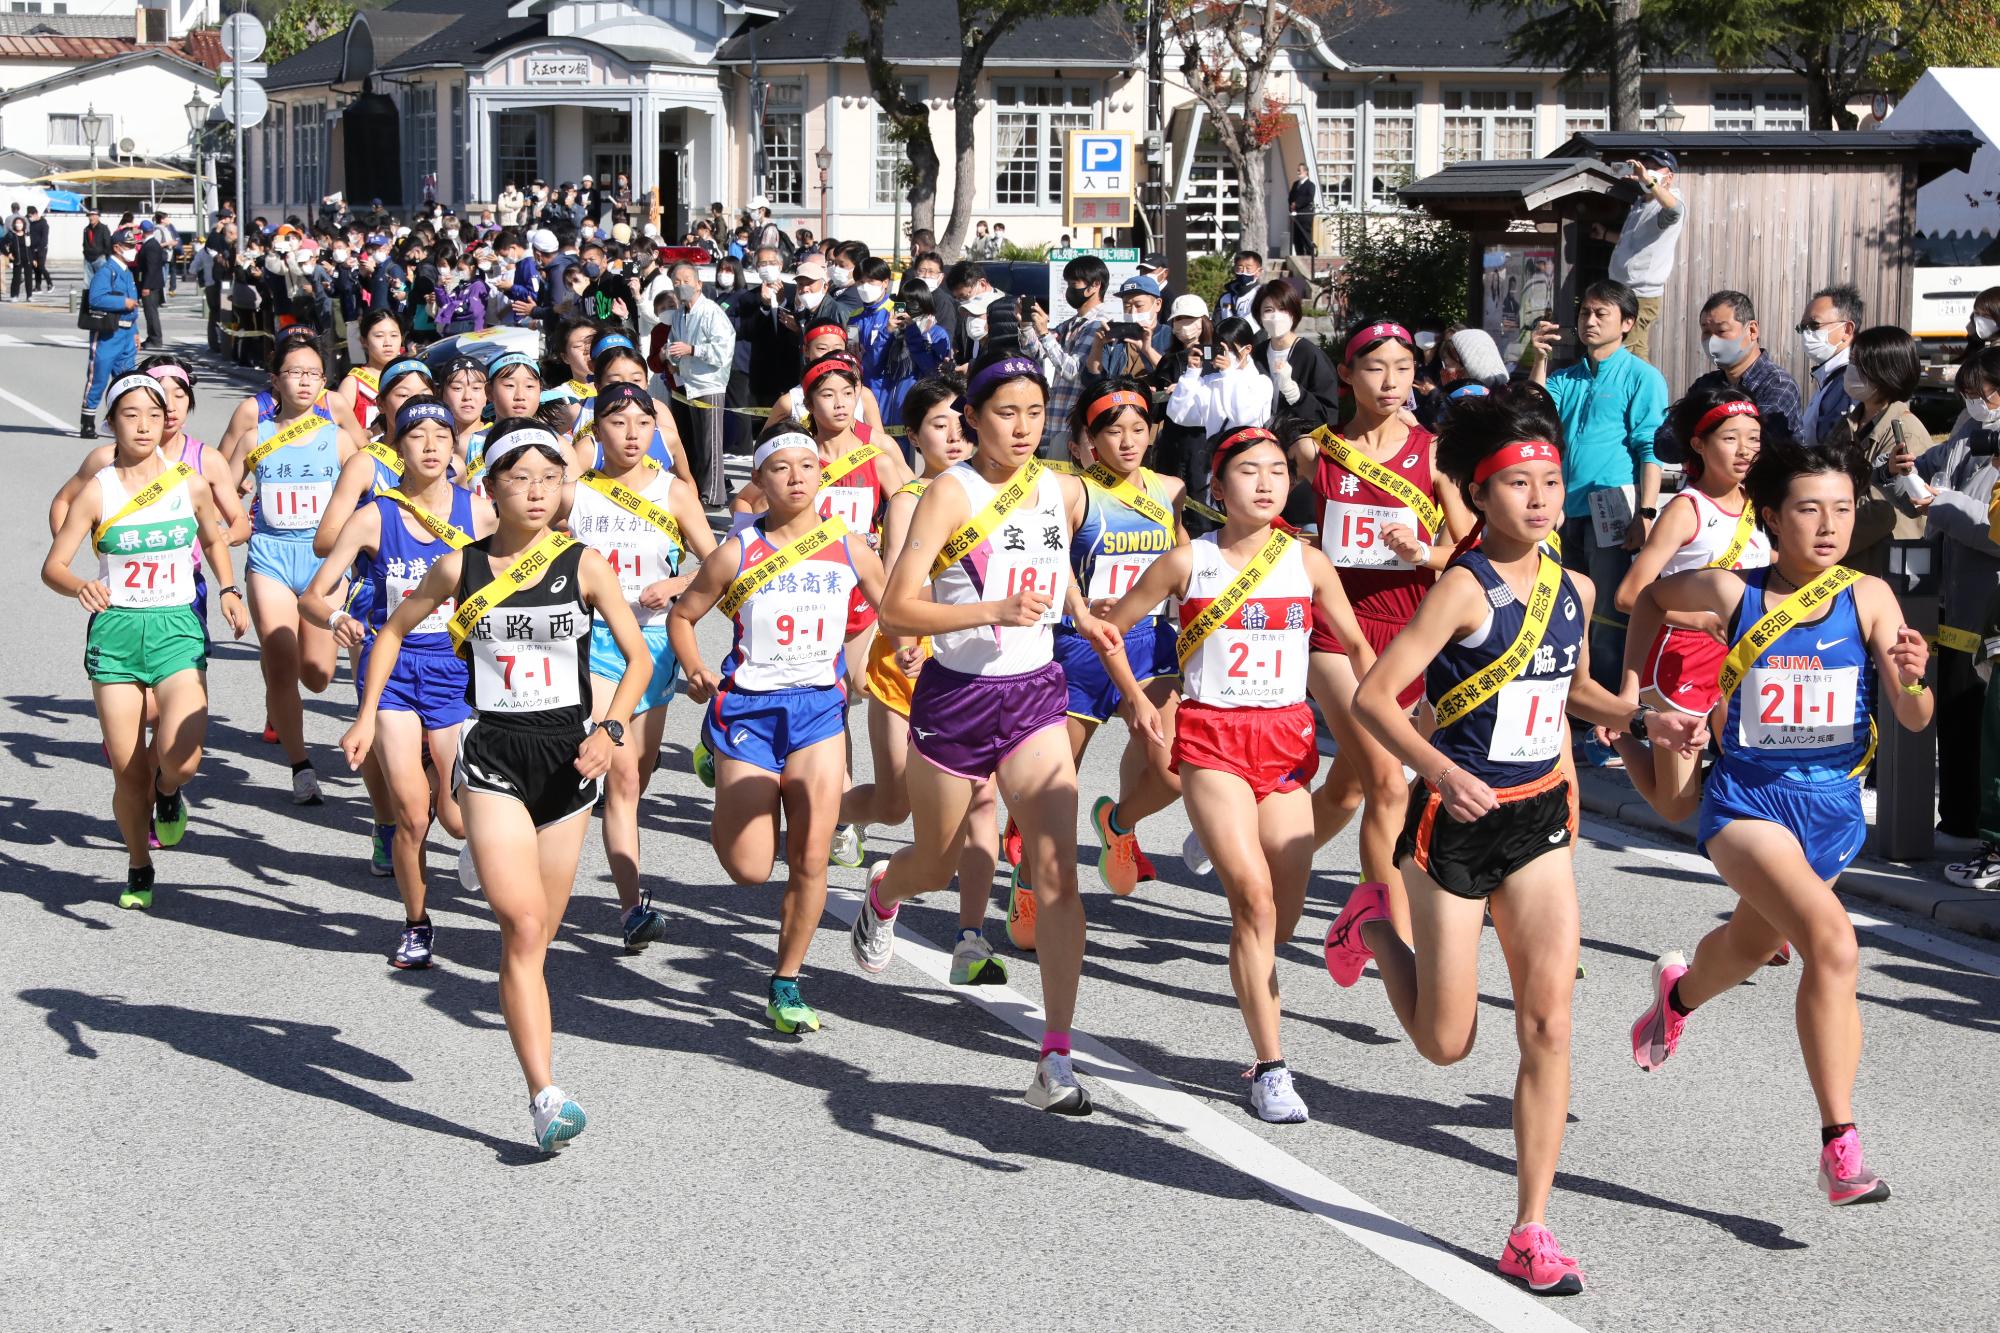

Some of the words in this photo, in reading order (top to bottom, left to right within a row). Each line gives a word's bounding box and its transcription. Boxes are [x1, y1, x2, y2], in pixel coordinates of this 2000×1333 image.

[531, 62, 587, 75] 大正ロマン館
[1086, 141, 1117, 170] P
[1083, 176, 1120, 189] 入口
[1082, 202, 1121, 218] 満車
[1373, 324, 1401, 336] 津名
[409, 406, 446, 419] 神港学園
[510, 431, 546, 444] 姫路西
[1519, 444, 1553, 458] 西工
[260, 463, 334, 479] 北摂三田
[276, 491, 318, 515] 11-1
[1366, 508, 1399, 519] 日本旅行
[116, 525, 189, 551] 県西宮
[1003, 524, 1064, 551] 宝塚
[124, 560, 176, 589] 27-1
[1006, 567, 1058, 601] 18-1
[470, 611, 575, 642] 姫路西
[776, 614, 824, 646] 9-1
[1749, 610, 1793, 648] 第39回
[1251, 633, 1286, 642] 日本旅行
[1227, 642, 1282, 679] 2-1
[1766, 655, 1824, 670] SUMA
[496, 655, 552, 690] 7-1
[1792, 673, 1833, 683] 日本旅行
[1760, 683, 1835, 725] 21-1
[1525, 695, 1565, 737] 1-1
[1778, 733, 1835, 745] JAバンク兵庫
